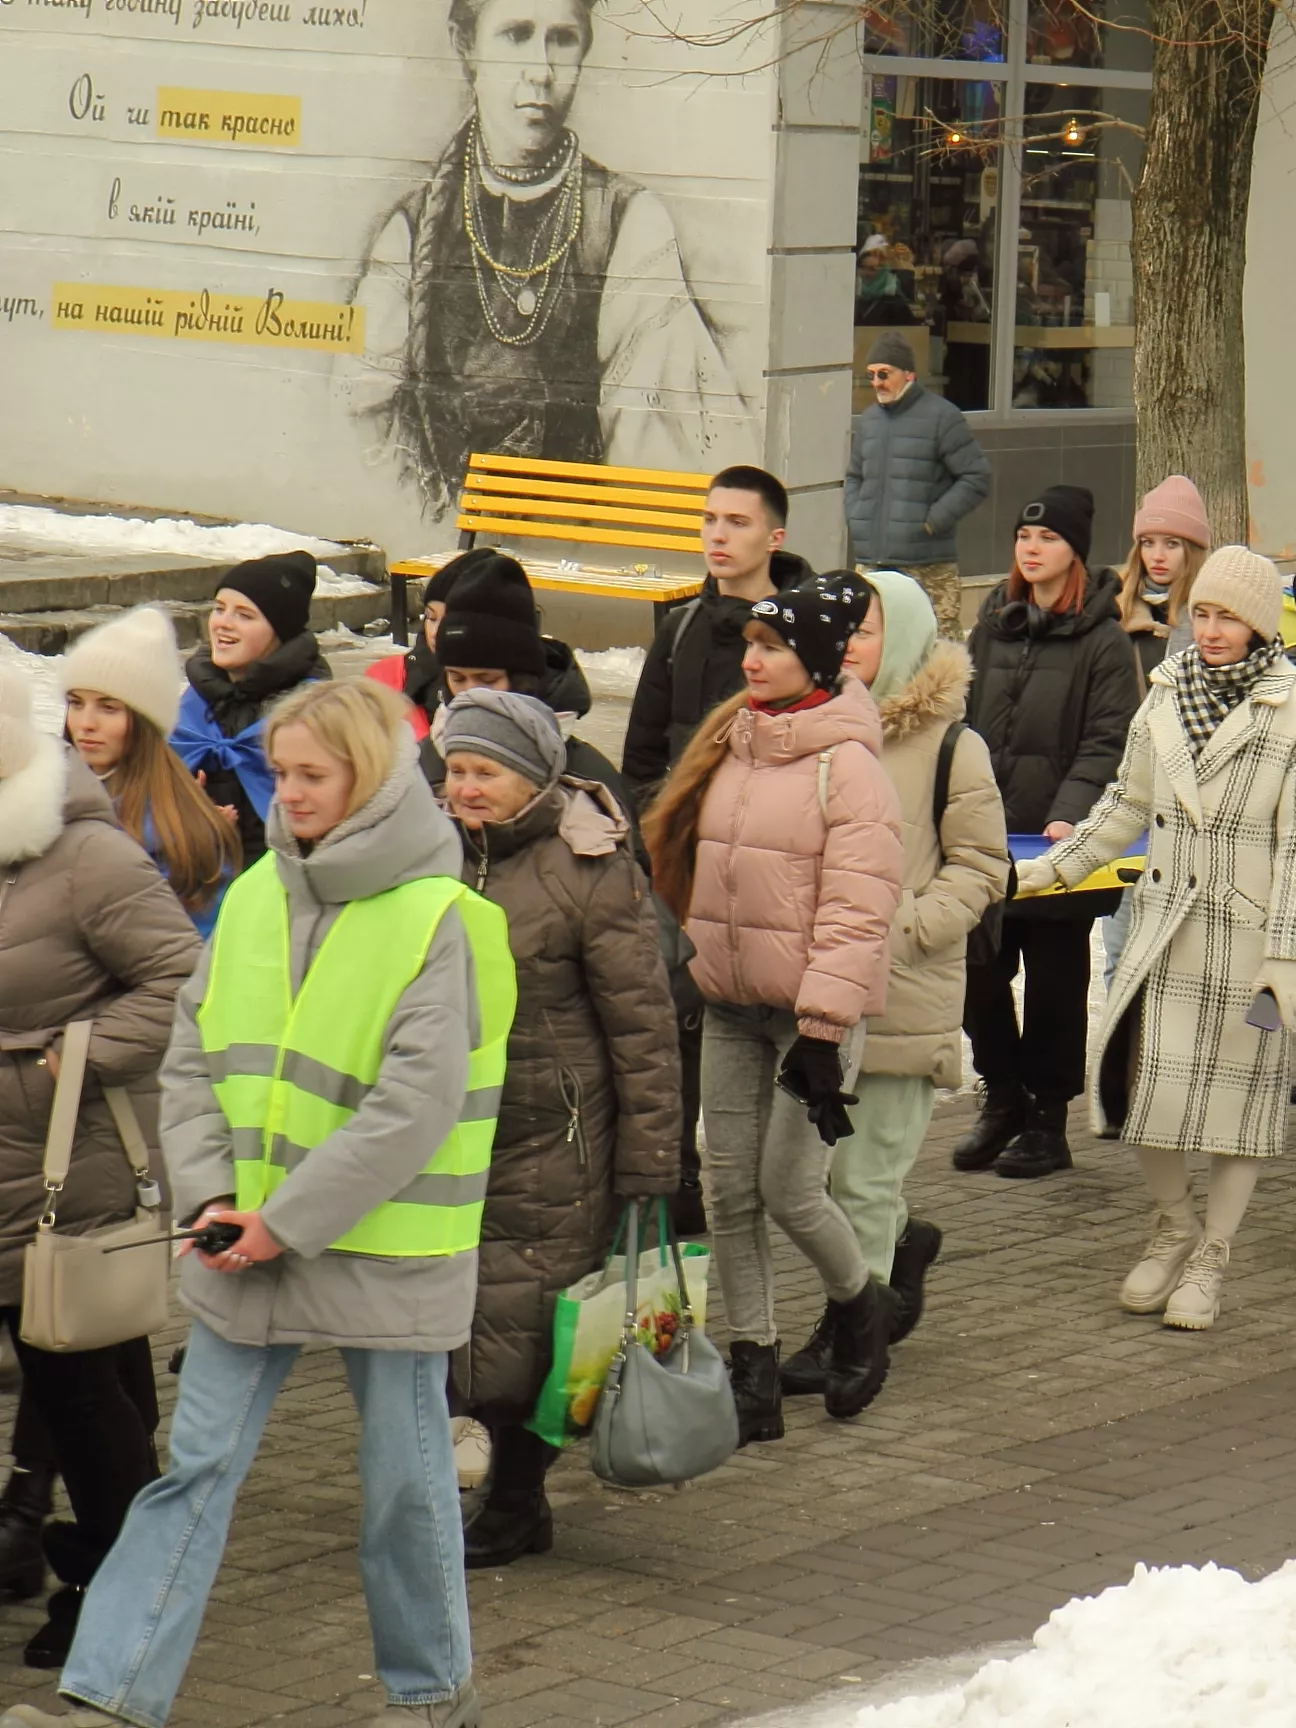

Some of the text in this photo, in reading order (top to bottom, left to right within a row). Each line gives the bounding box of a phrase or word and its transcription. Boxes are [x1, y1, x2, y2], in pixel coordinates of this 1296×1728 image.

[105, 0, 184, 25] гоину
[303, 0, 367, 28] лихо!
[69, 73, 296, 141] Ой чи так красно
[108, 177, 260, 237] в якій країні,
[0, 287, 355, 342] ут, на нашій рідній Волині!
